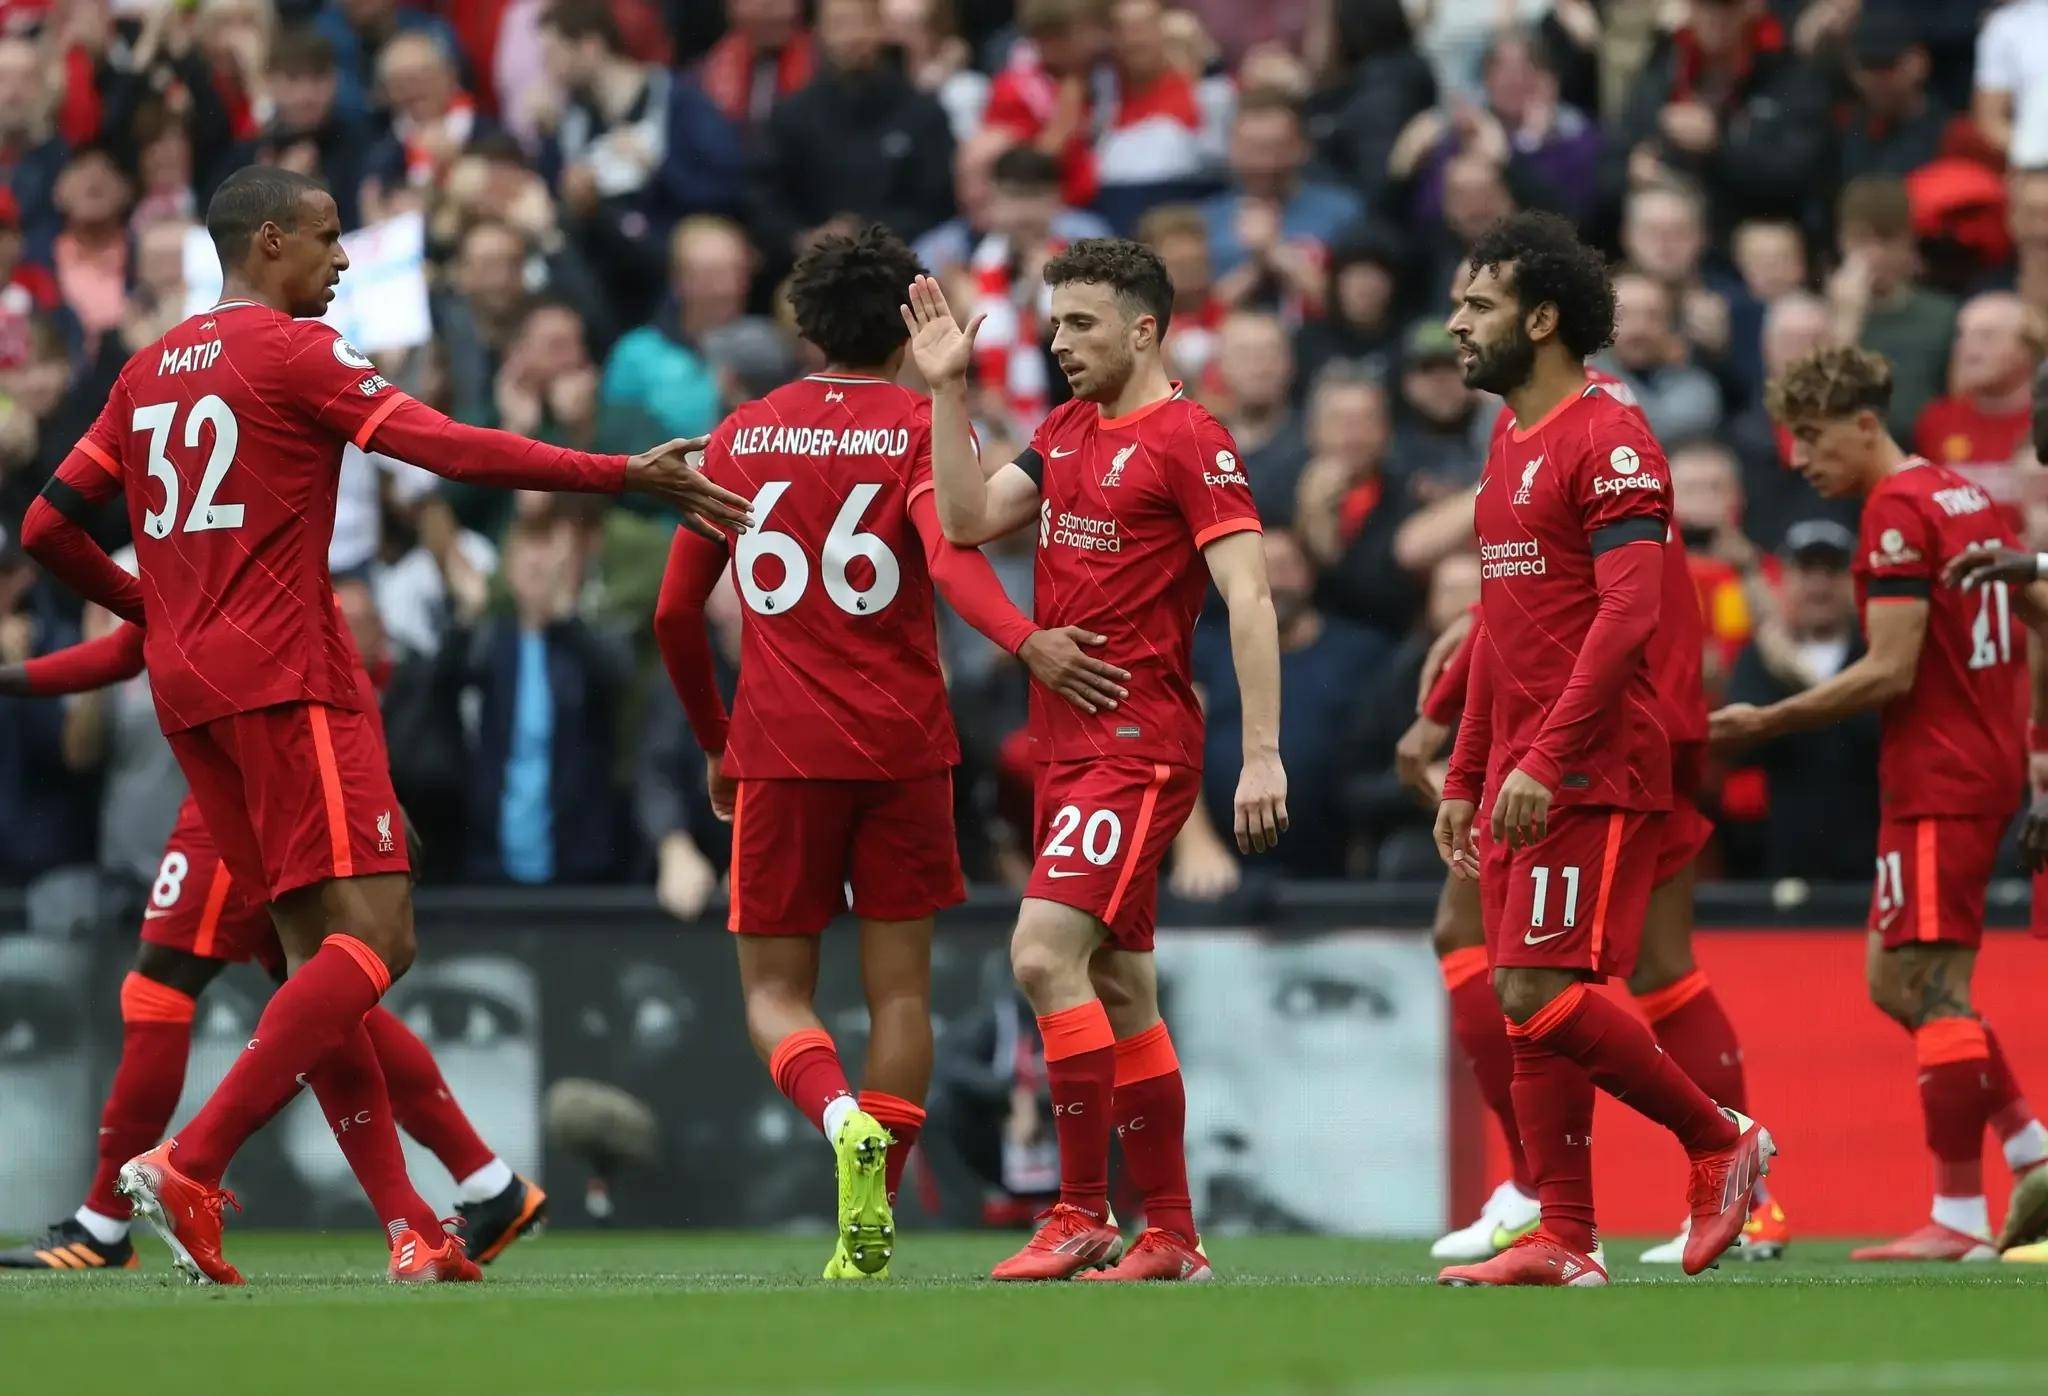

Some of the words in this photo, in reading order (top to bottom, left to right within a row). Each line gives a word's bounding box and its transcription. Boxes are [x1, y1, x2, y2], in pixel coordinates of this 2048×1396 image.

[158, 339, 222, 376] MATIP
[730, 425, 909, 457] ALEXANDER-ARNOLD
[132, 394, 245, 540] 32
[1593, 472, 1661, 496] Expedia
[1057, 511, 1116, 536] standard
[734, 481, 901, 616] 66
[1053, 528, 1120, 553] chartered
[1481, 537, 1539, 561] standard
[1482, 556, 1546, 580] chartered
[1041, 804, 1122, 866] 20
[152, 850, 188, 908] 8
[1530, 866, 1580, 927] 11
[332, 1110, 371, 1139] FC
[1052, 1102, 1084, 1117] FC
